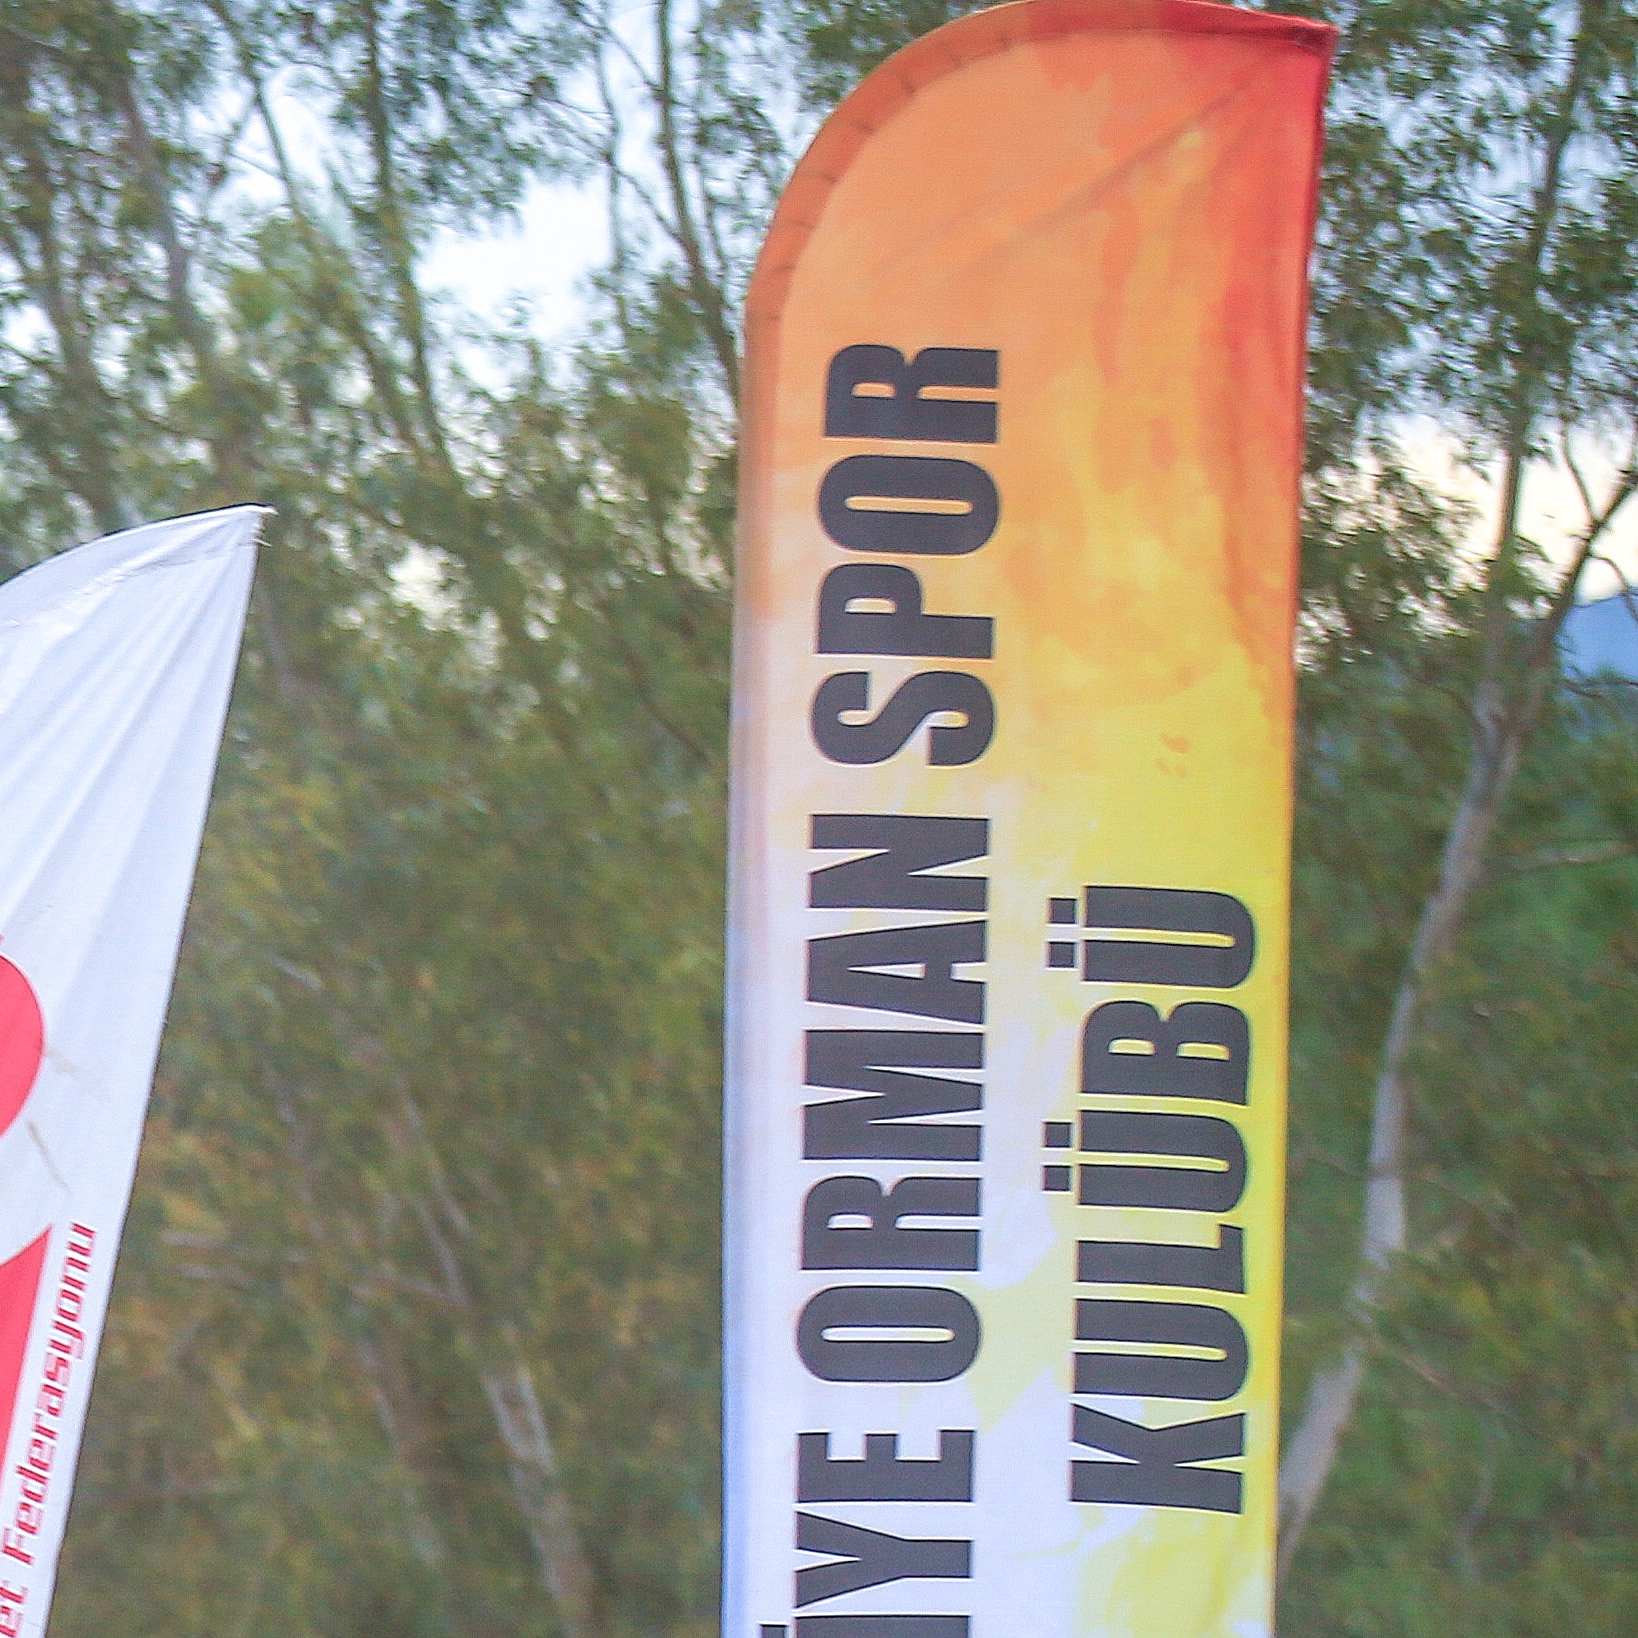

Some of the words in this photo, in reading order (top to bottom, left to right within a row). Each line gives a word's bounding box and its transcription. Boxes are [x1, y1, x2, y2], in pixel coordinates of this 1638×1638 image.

[811, 344, 1001, 767] SPOR
[795, 814, 990, 1384] ORMAN
[1042, 884, 1255, 1516] KULÜBÜ
